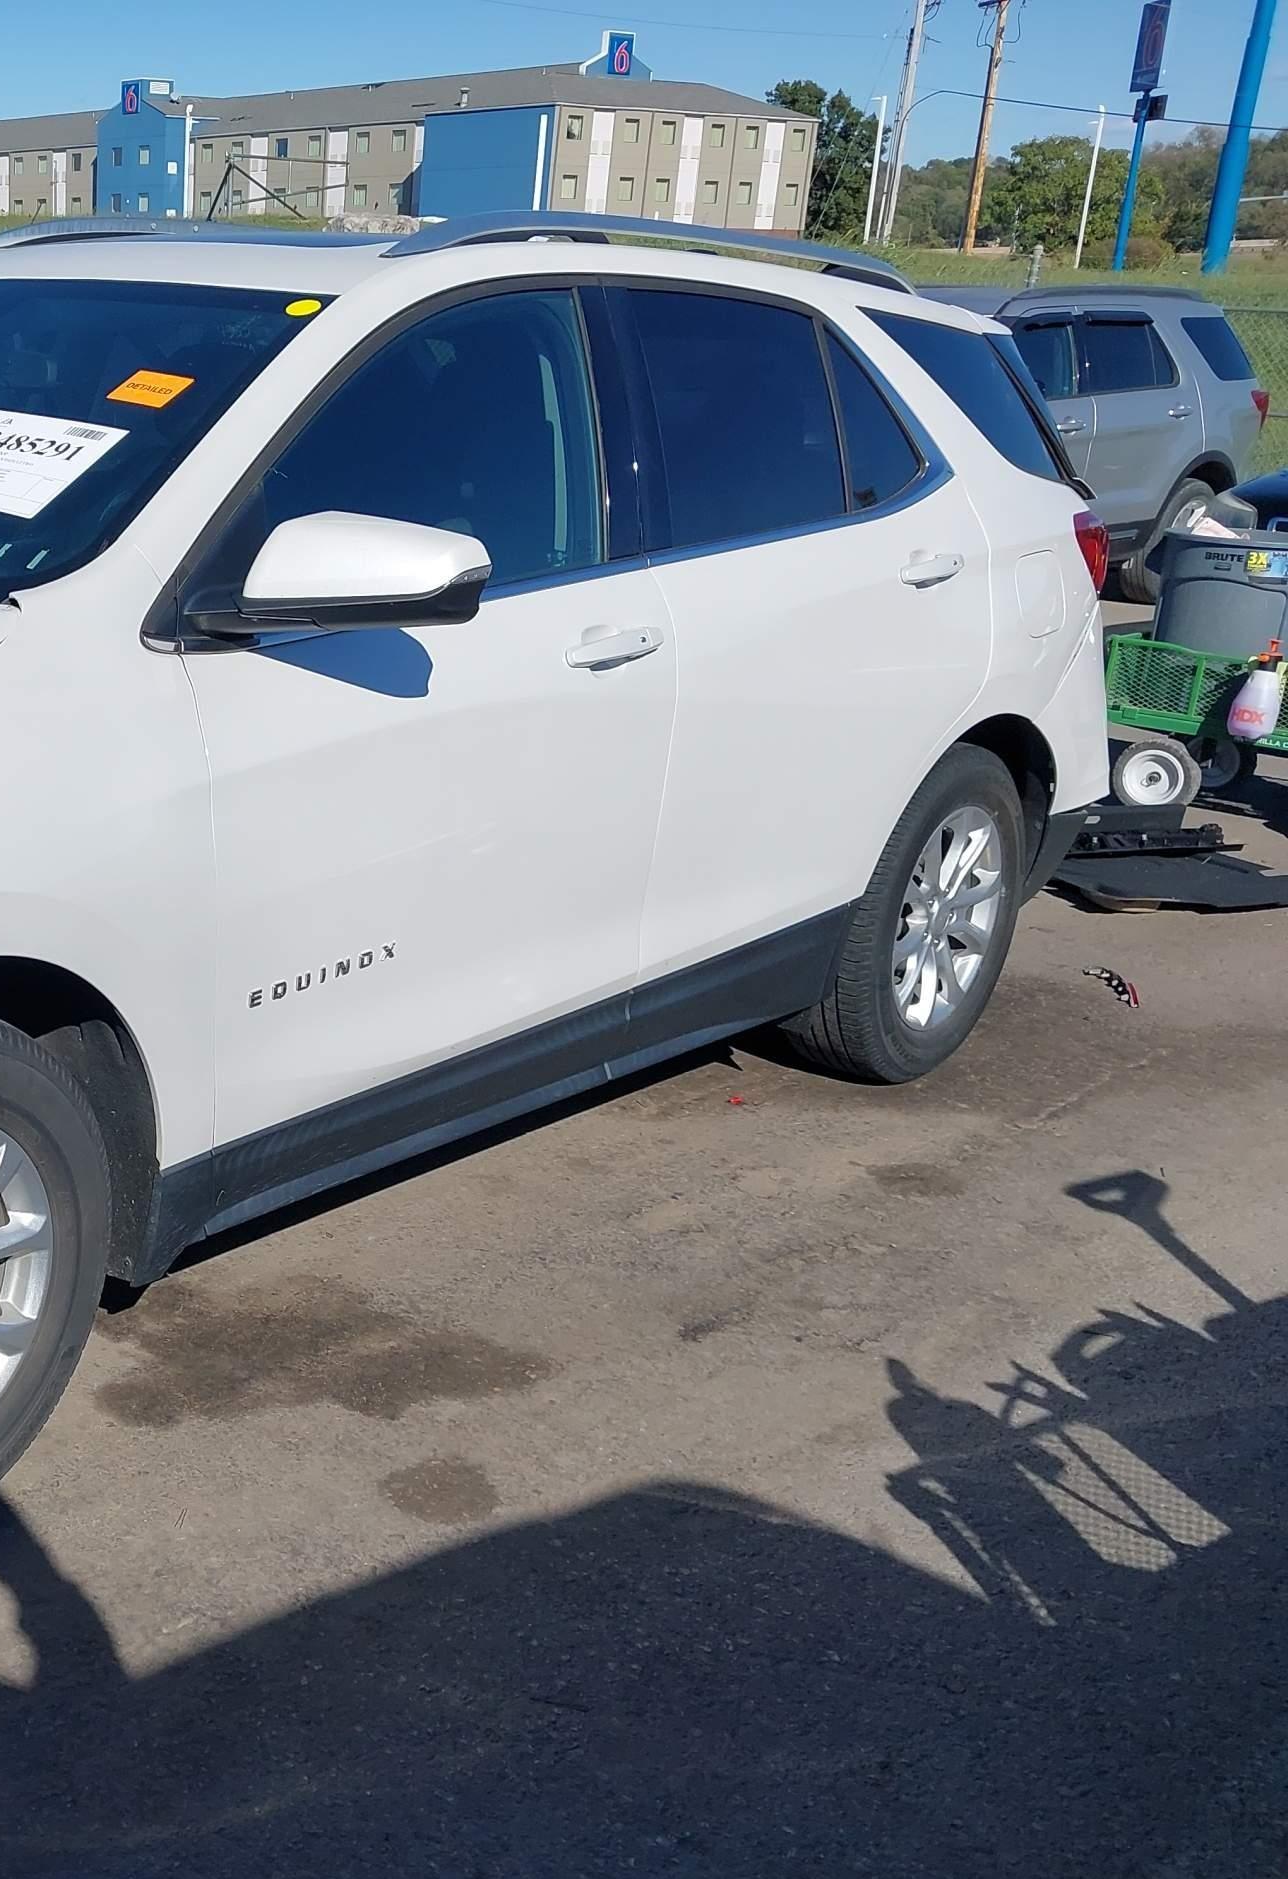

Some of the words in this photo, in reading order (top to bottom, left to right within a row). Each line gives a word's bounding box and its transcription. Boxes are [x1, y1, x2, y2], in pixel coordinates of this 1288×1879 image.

[614, 40, 630, 75] 6
[125, 84, 137, 113] 6
[126, 382, 173, 395] DETAILED
[1204, 551, 1245, 563] BRUTE
[1247, 550, 1269, 566] 3X
[1233, 709, 1264, 724] HDX
[248, 942, 396, 1009] EQUINOX
